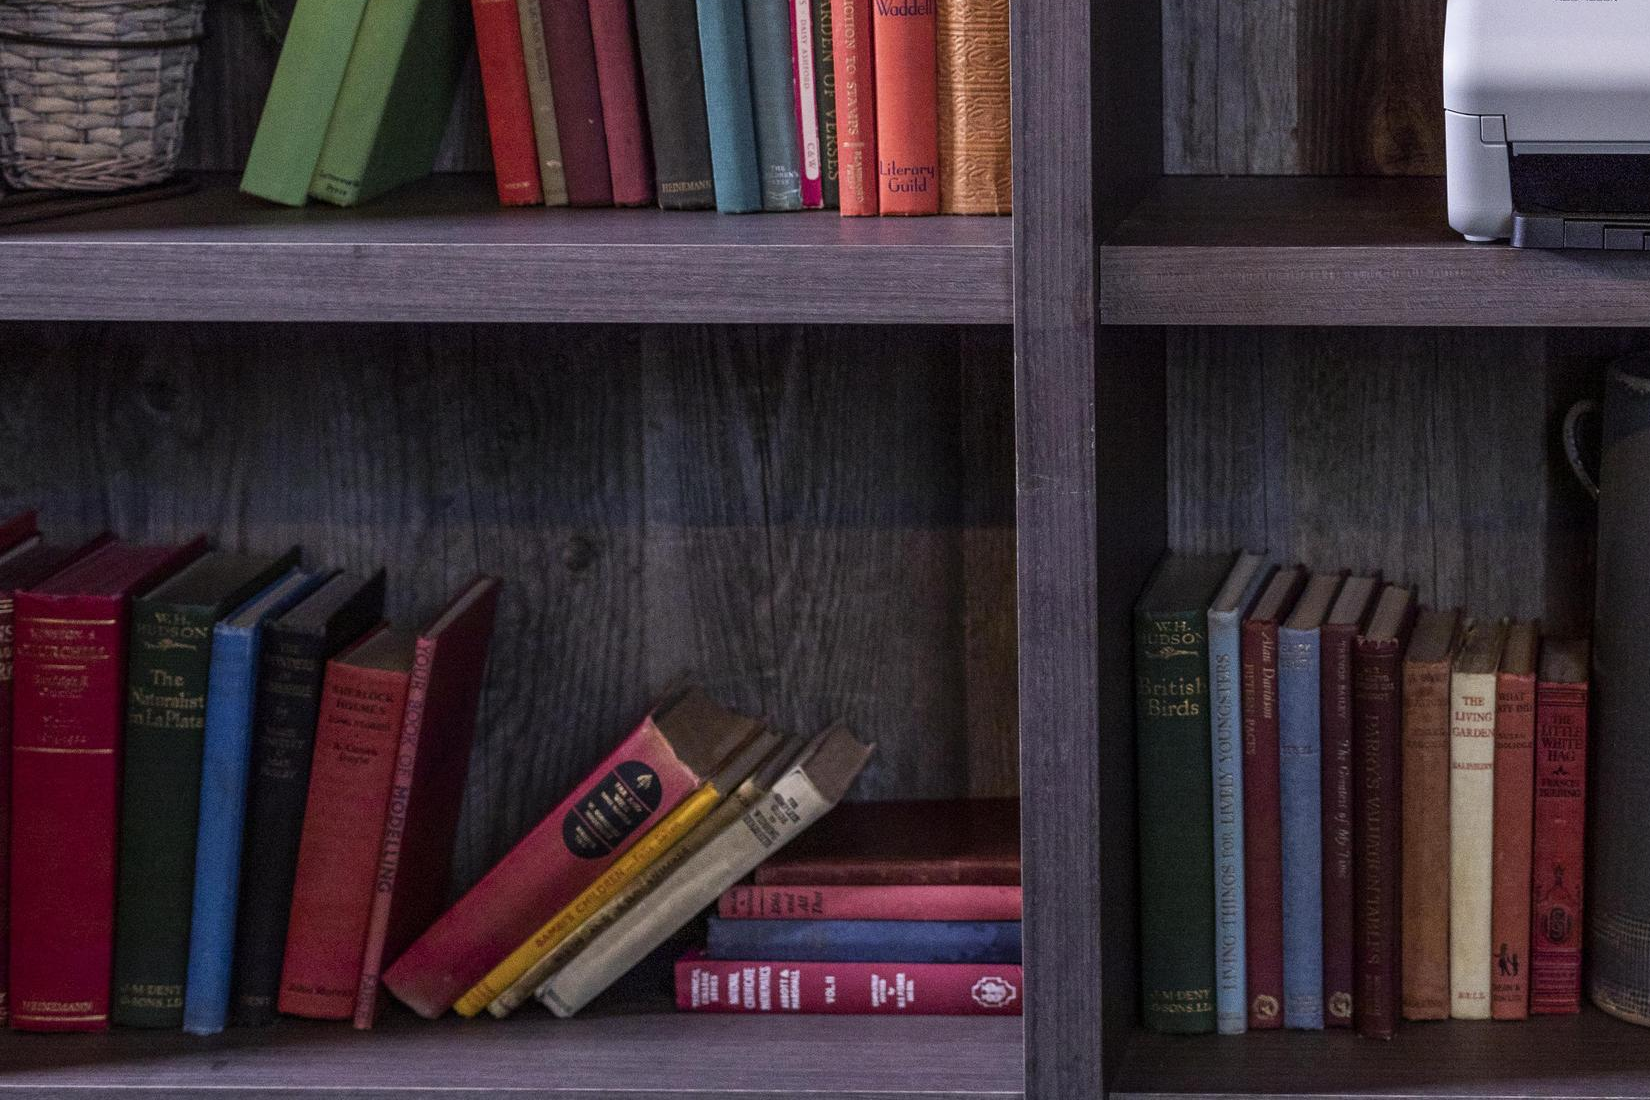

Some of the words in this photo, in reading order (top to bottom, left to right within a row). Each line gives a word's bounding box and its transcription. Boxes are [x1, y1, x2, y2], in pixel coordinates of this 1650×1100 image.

[876, 0, 935, 17] Waddell
[844, 55, 857, 73] TO
[822, 73, 836, 97] OF
[845, 78, 859, 134] STAMPS
[823, 107, 840, 181] VERSES
[879, 160, 935, 177] Literary
[662, 181, 711, 193] HEINEMANN
[888, 178, 927, 193] Guild
[137, 624, 208, 638] HUDSON
[1142, 632, 1207, 645] HUDSON
[1260, 631, 1274, 661] Alan
[411, 642, 433, 690] YOUR
[150, 669, 185, 687] The
[1139, 676, 1207, 696] British
[131, 687, 205, 709] Naturalist
[331, 684, 394, 702] SHERLOCK
[1261, 666, 1276, 719] Davidson
[1462, 696, 1485, 706] THE
[336, 700, 386, 715] HOLMES
[1148, 699, 1200, 717] Birds
[1214, 653, 1232, 764] YOUNGSTERS
[1455, 712, 1493, 722] LIVING
[128, 713, 144, 725] in
[147, 708, 163, 726] La
[166, 709, 205, 728] Plata
[401, 700, 423, 747] BOOK
[1552, 715, 1575, 725] THE
[1453, 728, 1493, 738] GARDEN
[1541, 726, 1583, 737] LITTLE
[1365, 714, 1380, 788] PARRY'S
[1542, 739, 1583, 749] WHITE
[396, 754, 414, 775] OF
[1547, 750, 1576, 762] HAG
[1217, 768, 1233, 824] LIVELY
[376, 786, 409, 894] MODELLING
[1366, 796, 1380, 890] VALUATION
[1219, 864, 1236, 925] THINGS
[1366, 898, 1380, 964] TABLES
[1222, 934, 1237, 992] LIVING
